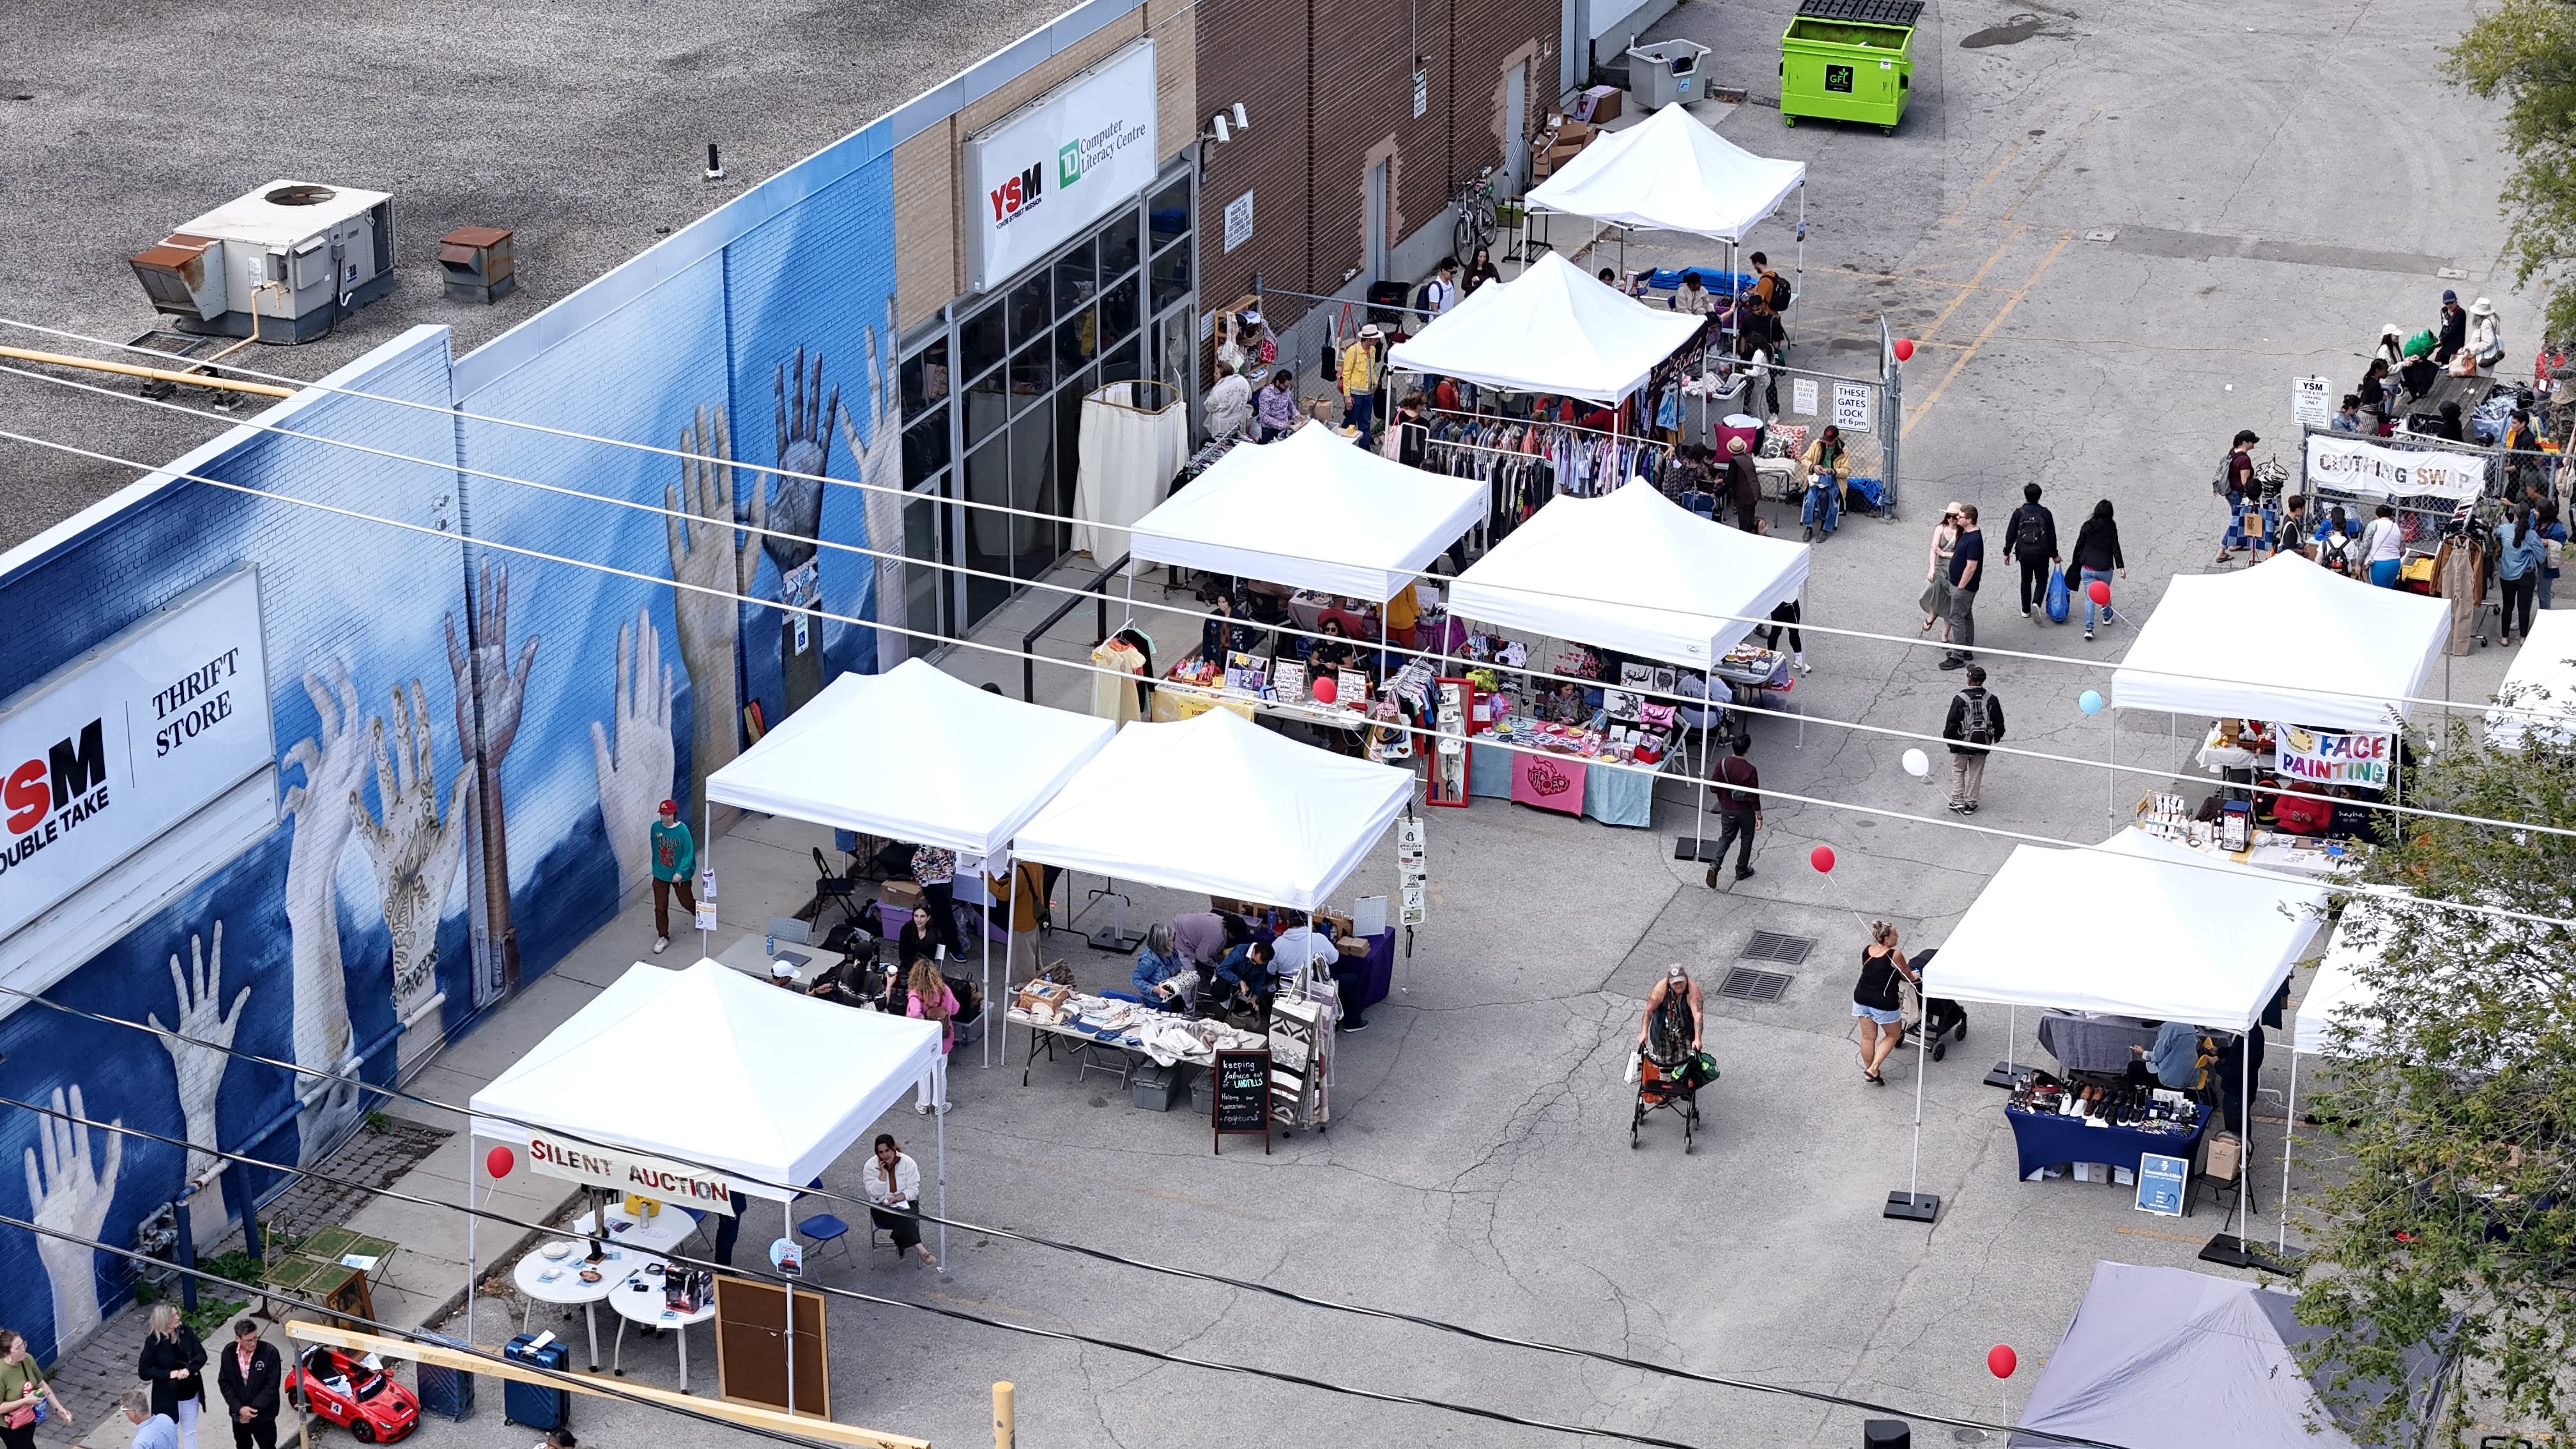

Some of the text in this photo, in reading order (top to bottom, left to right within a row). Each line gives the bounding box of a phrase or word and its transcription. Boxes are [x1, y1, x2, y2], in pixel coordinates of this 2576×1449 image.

[1830, 71, 1849, 84] GFL
[1080, 119, 1123, 154] Computer
[1081, 124, 1146, 174] Literacy Centre
[1061, 148, 1078, 179] TD
[990, 161, 1041, 222] YSM
[1009, 208, 1025, 222] STREET
[1025, 197, 1042, 212] MISSION
[1838, 388, 1866, 397] THESE
[2303, 382, 2323, 391] YSM
[1837, 398, 1866, 408] GATES
[1839, 408, 1863, 418] LOCK
[2319, 454, 2470, 489] CLOTHING SWAP
[152, 647, 239, 721] THRIFT
[157, 690, 232, 758] STORE
[2320, 735, 2387, 759] FACE
[0, 717, 106, 834] SM
[2283, 752, 2385, 783] PAINTING
[59, 785, 109, 832] TAKE
[1223, 1060, 1255, 1072] keeping
[1223, 1071, 1250, 1084] fabrics
[1222, 1092, 1239, 1101] Helping
[1234, 1078, 1263, 1089] LANDFILLS
[530, 1139, 728, 1202] SILENT AUCTION
